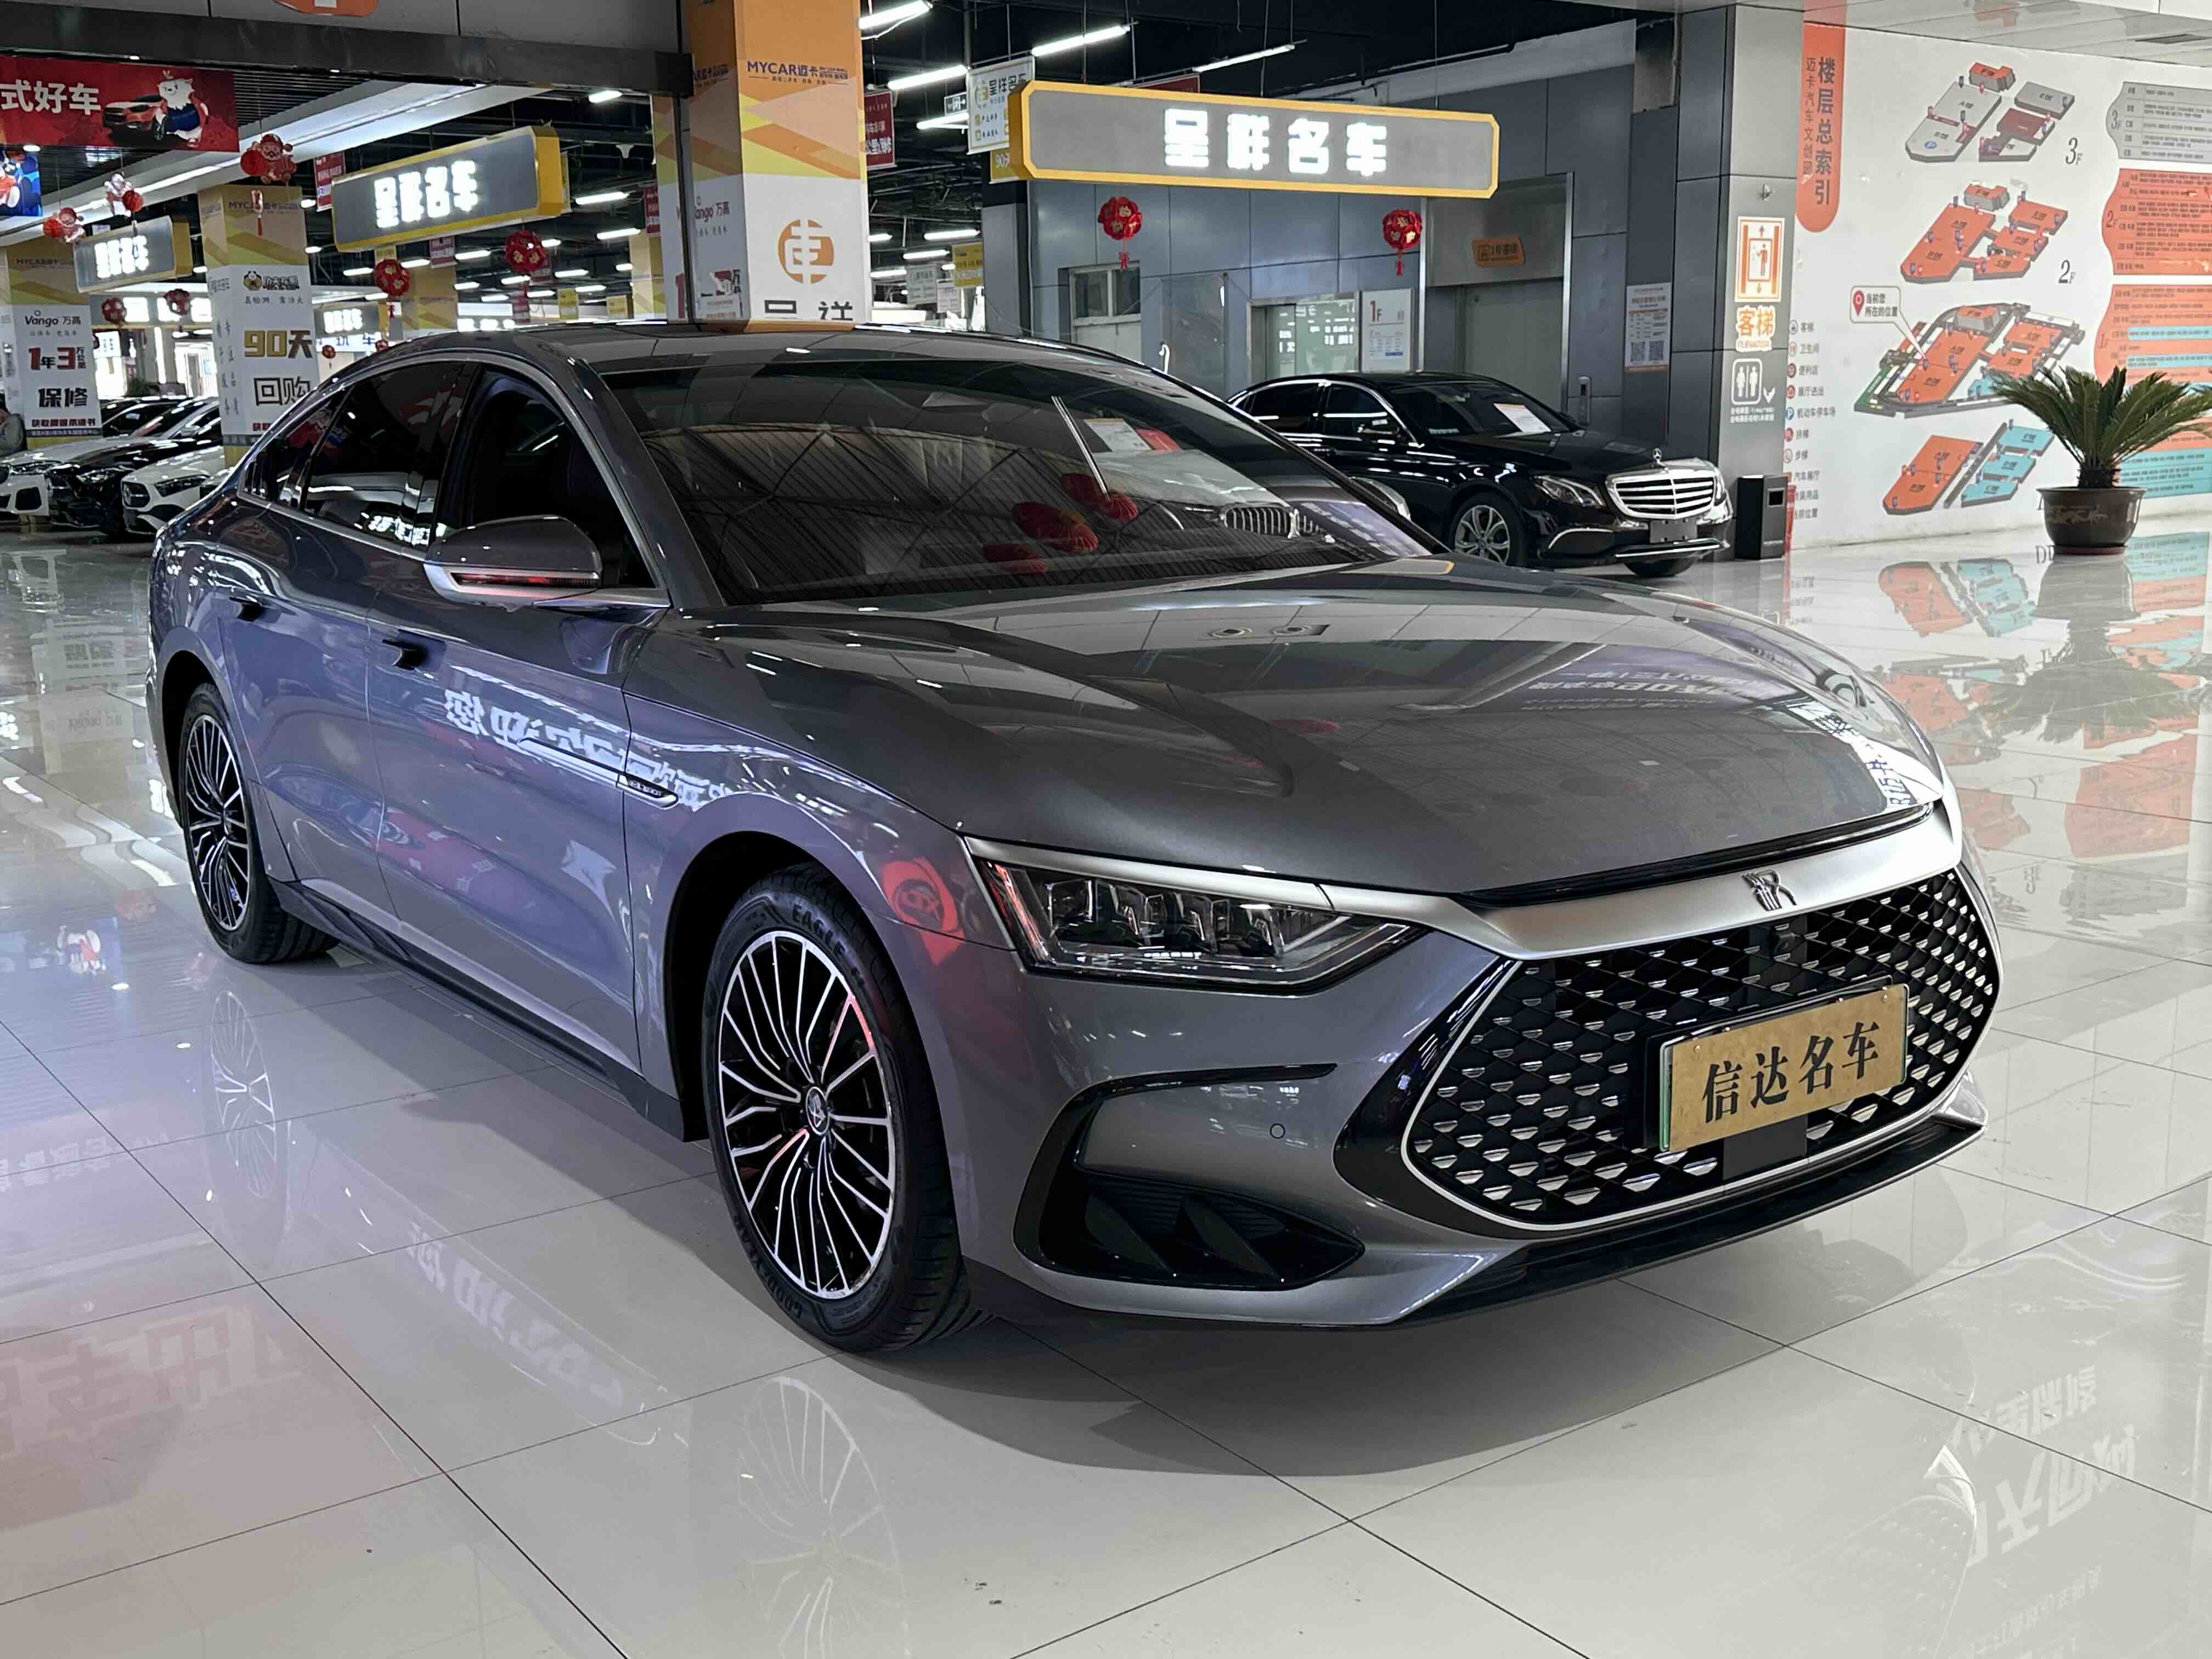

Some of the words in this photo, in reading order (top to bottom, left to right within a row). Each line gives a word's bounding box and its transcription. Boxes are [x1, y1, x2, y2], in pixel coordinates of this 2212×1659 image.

[0, 78, 101, 115] 式好车
[1814, 57, 1835, 206] 楼层总索引
[1736, 306, 1775, 337] 客梯
[244, 330, 313, 359] 90天
[38, 387, 88, 408] 保修
[1702, 1022, 1879, 1124] 信达名车
